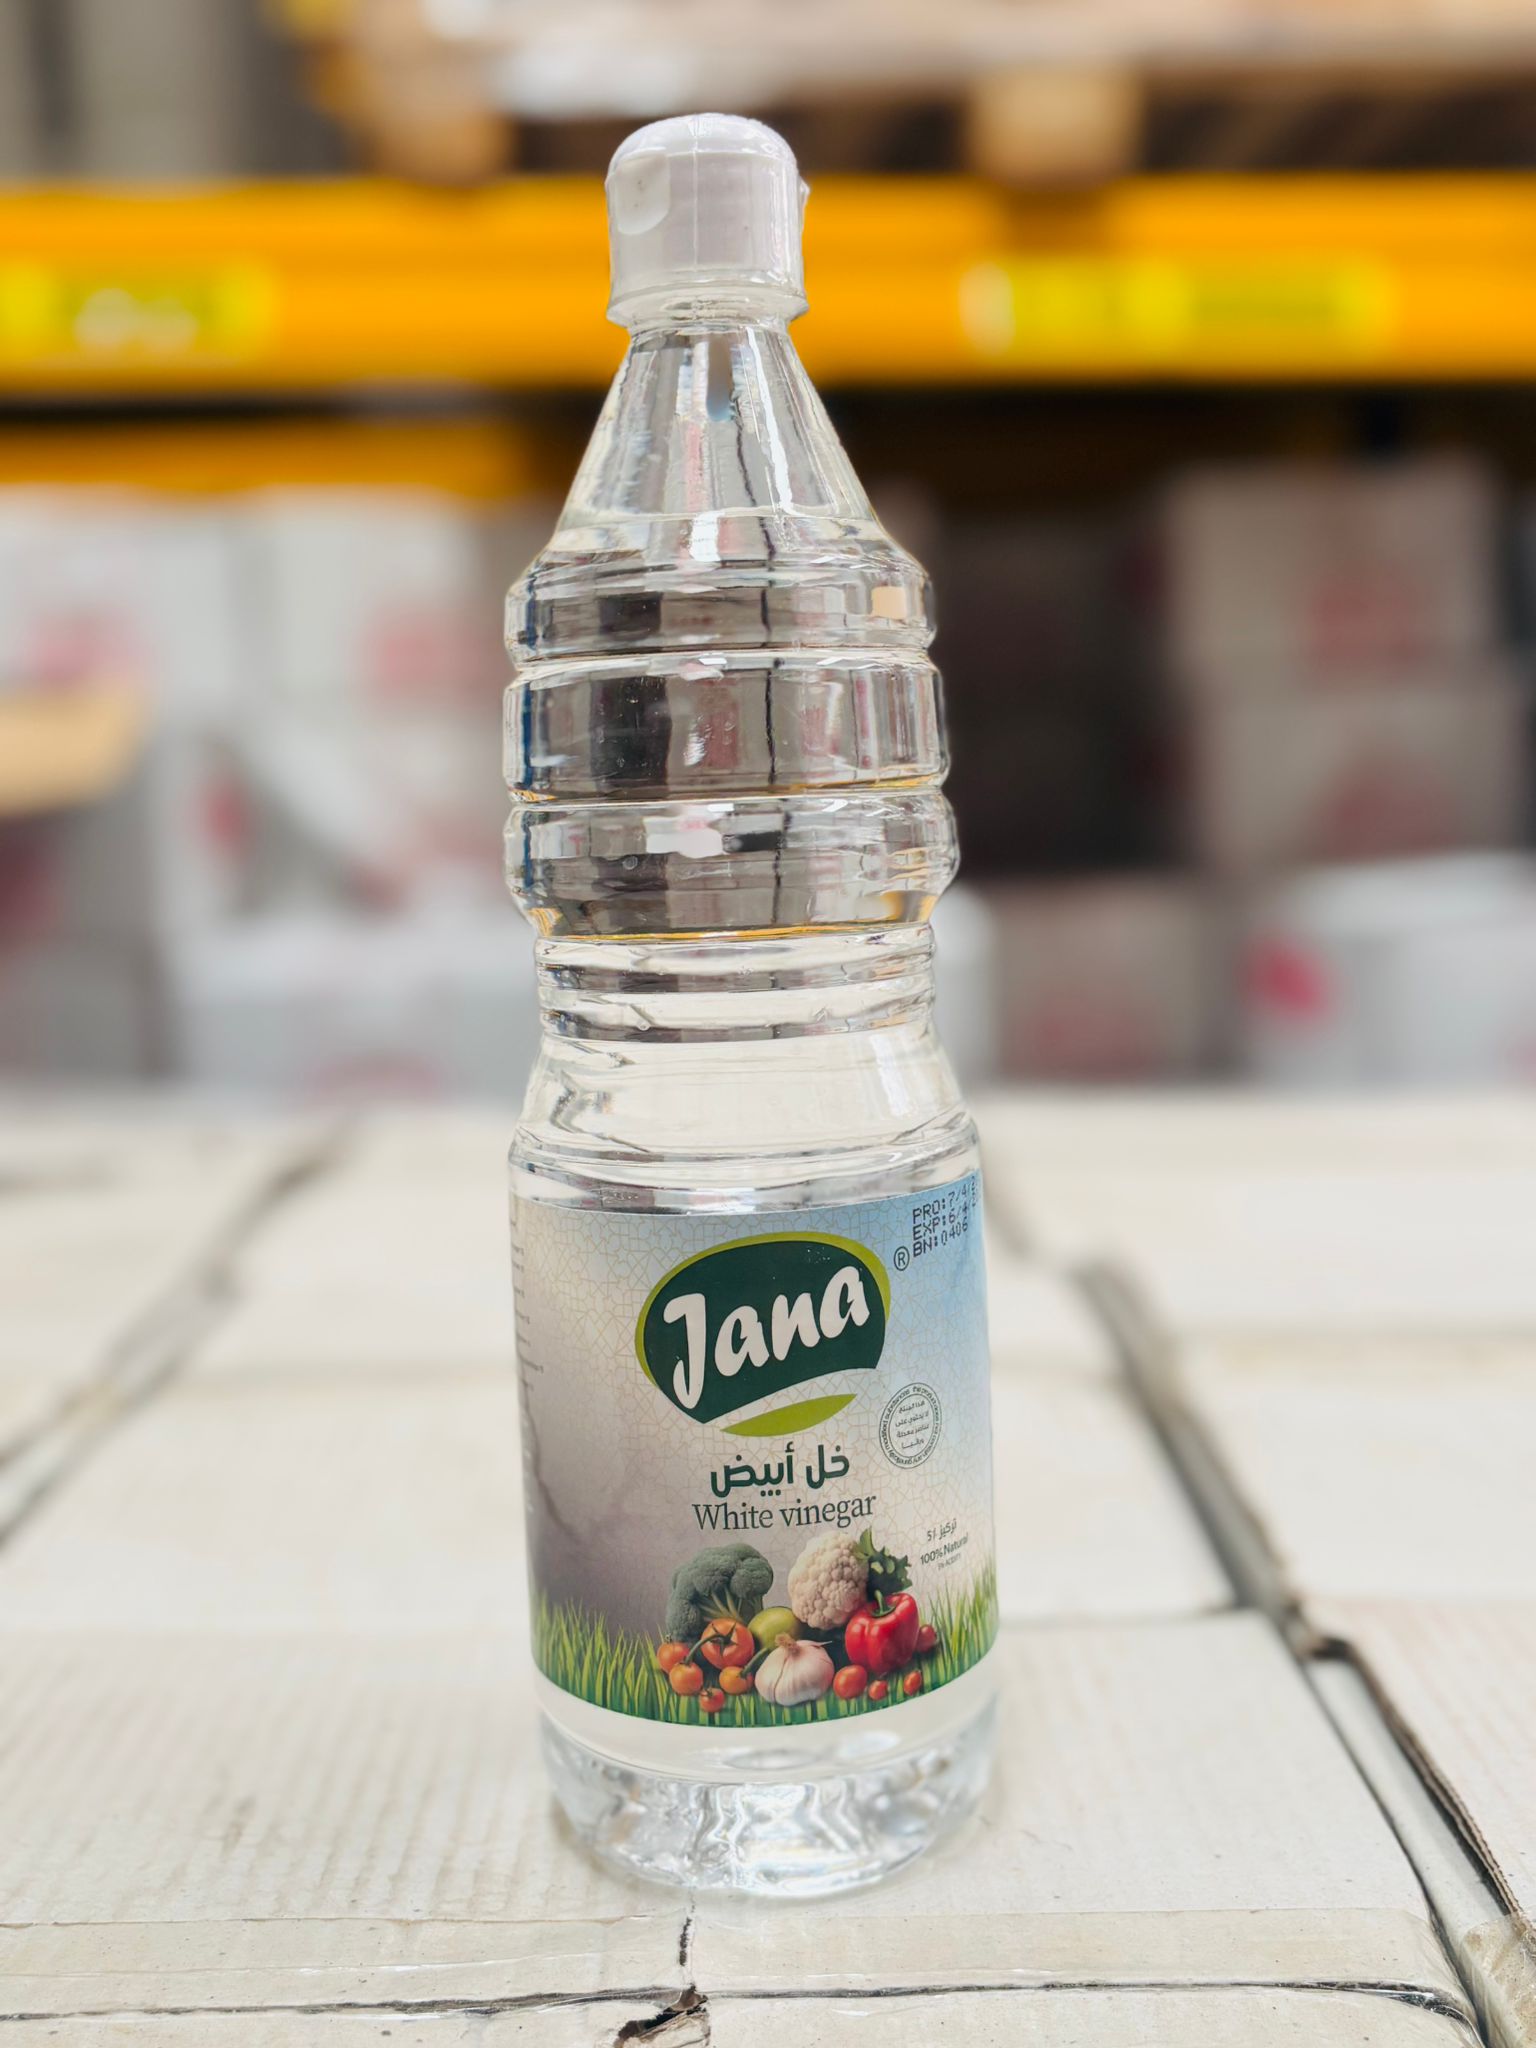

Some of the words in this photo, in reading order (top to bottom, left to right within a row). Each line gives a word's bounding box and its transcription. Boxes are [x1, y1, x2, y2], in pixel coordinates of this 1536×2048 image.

[663, 1266, 870, 1410] Jana
[710, 1441, 795, 1498] أبيض
[806, 1444, 850, 1489] خل
[692, 1502, 774, 1531] White
[779, 1495, 877, 1529] vinegar
